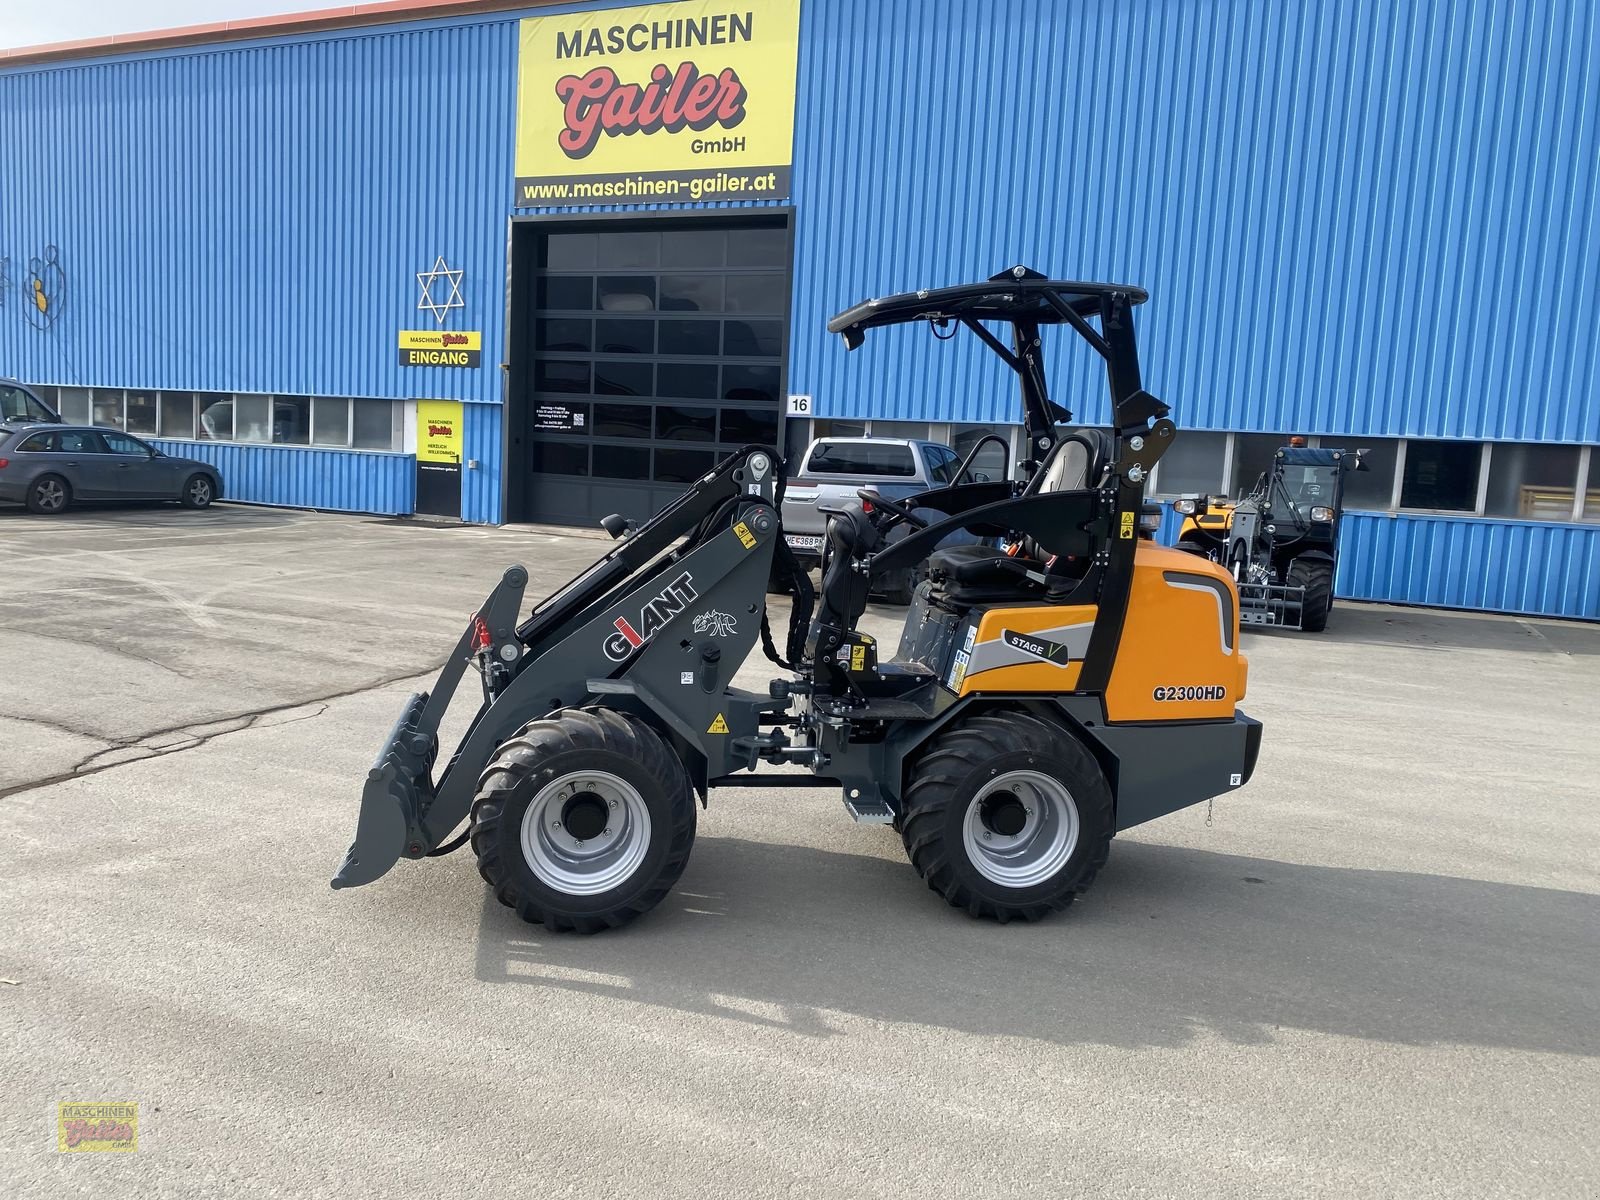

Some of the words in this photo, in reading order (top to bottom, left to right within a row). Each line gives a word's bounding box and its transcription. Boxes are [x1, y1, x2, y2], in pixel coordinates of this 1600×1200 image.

[556, 12, 753, 59] MASCHINEN
[555, 61, 748, 160] Gailer
[691, 137, 746, 154] GmbH
[523, 172, 776, 200] www.maschinen-gailer.at
[409, 351, 469, 365] EINGANG
[793, 399, 808, 411] 16
[602, 571, 699, 662] GIANT
[1011, 636, 1044, 655] STAGE
[1152, 685, 1227, 702] G2300HD
